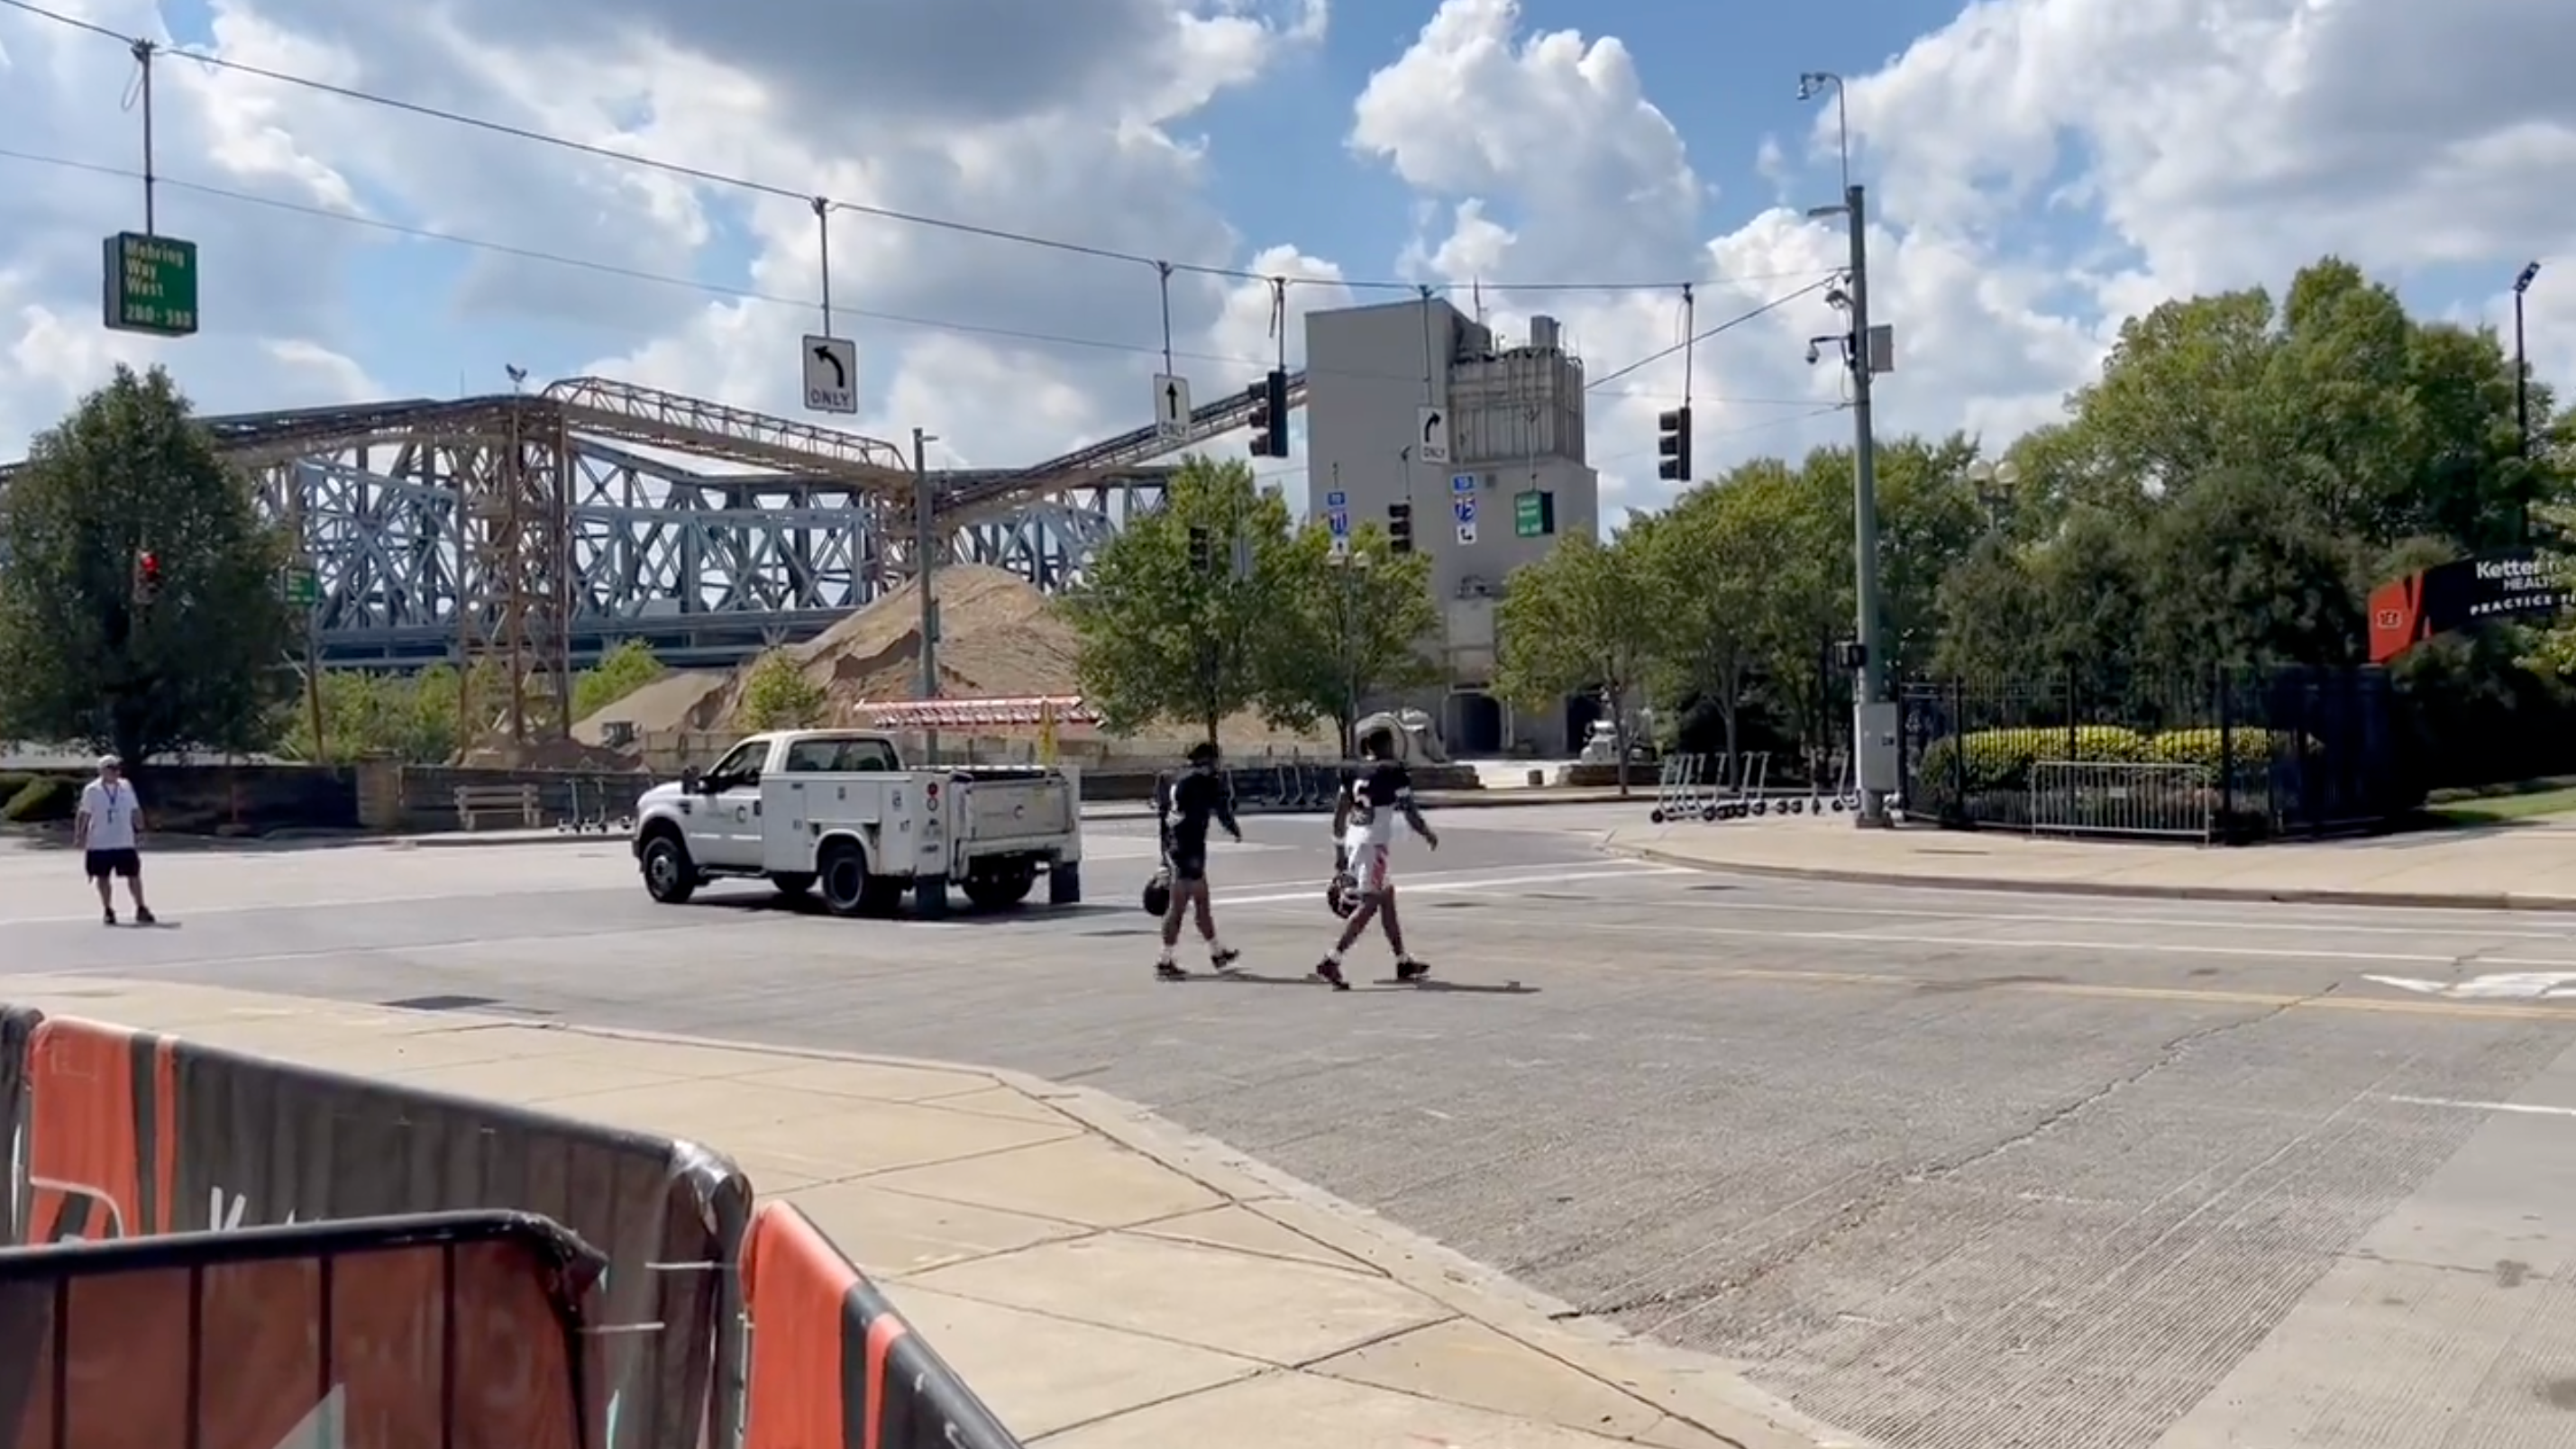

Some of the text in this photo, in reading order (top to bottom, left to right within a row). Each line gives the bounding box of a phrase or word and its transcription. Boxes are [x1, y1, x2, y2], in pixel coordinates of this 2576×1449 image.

[125, 257, 157, 281] Way
[125, 275, 164, 297] West
[810, 387, 850, 407] ONLY
[2470, 594, 2552, 616] PRACTICE
